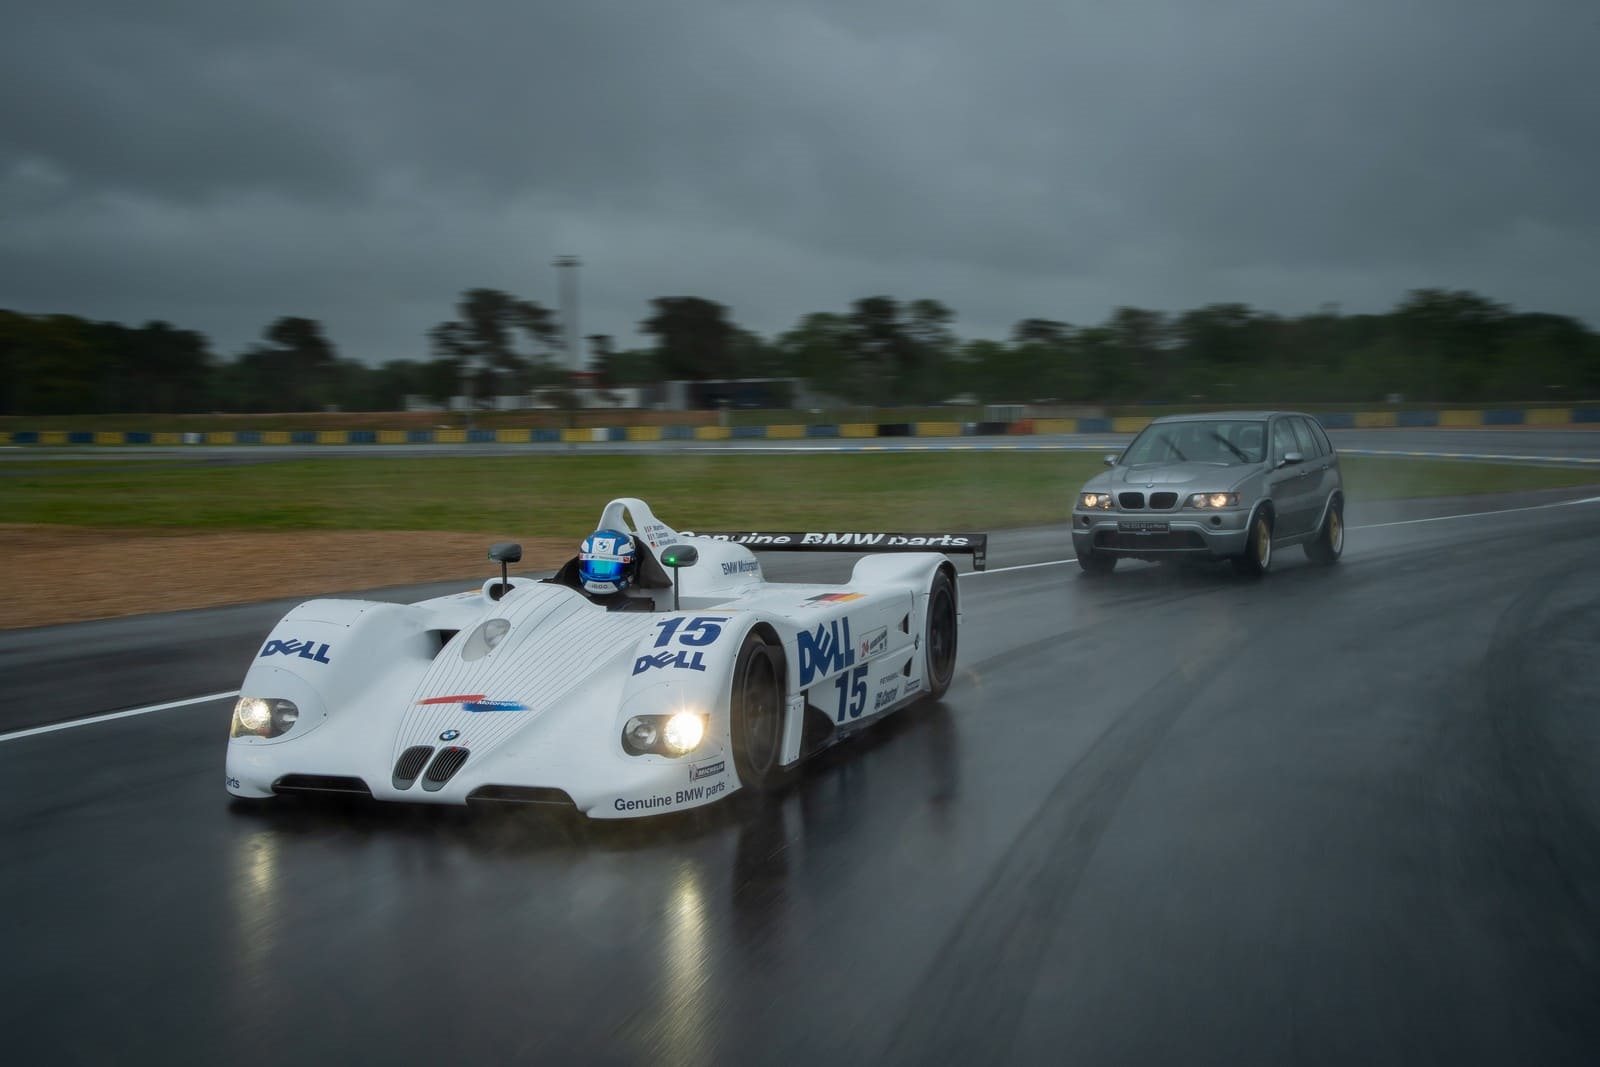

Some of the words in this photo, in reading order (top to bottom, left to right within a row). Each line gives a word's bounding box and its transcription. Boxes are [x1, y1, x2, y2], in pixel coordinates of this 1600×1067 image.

[800, 532, 886, 545] BMW
[888, 534, 969, 546] parts
[721, 561, 738, 576] BMW
[653, 616, 728, 648] 15
[259, 638, 330, 664] DELL
[632, 650, 707, 676] DELL
[796, 616, 855, 688] DELL
[835, 662, 869, 722] 15
[614, 795, 672, 811] Genuine
[676, 786, 704, 804] BMW
[706, 780, 725, 799] parts
